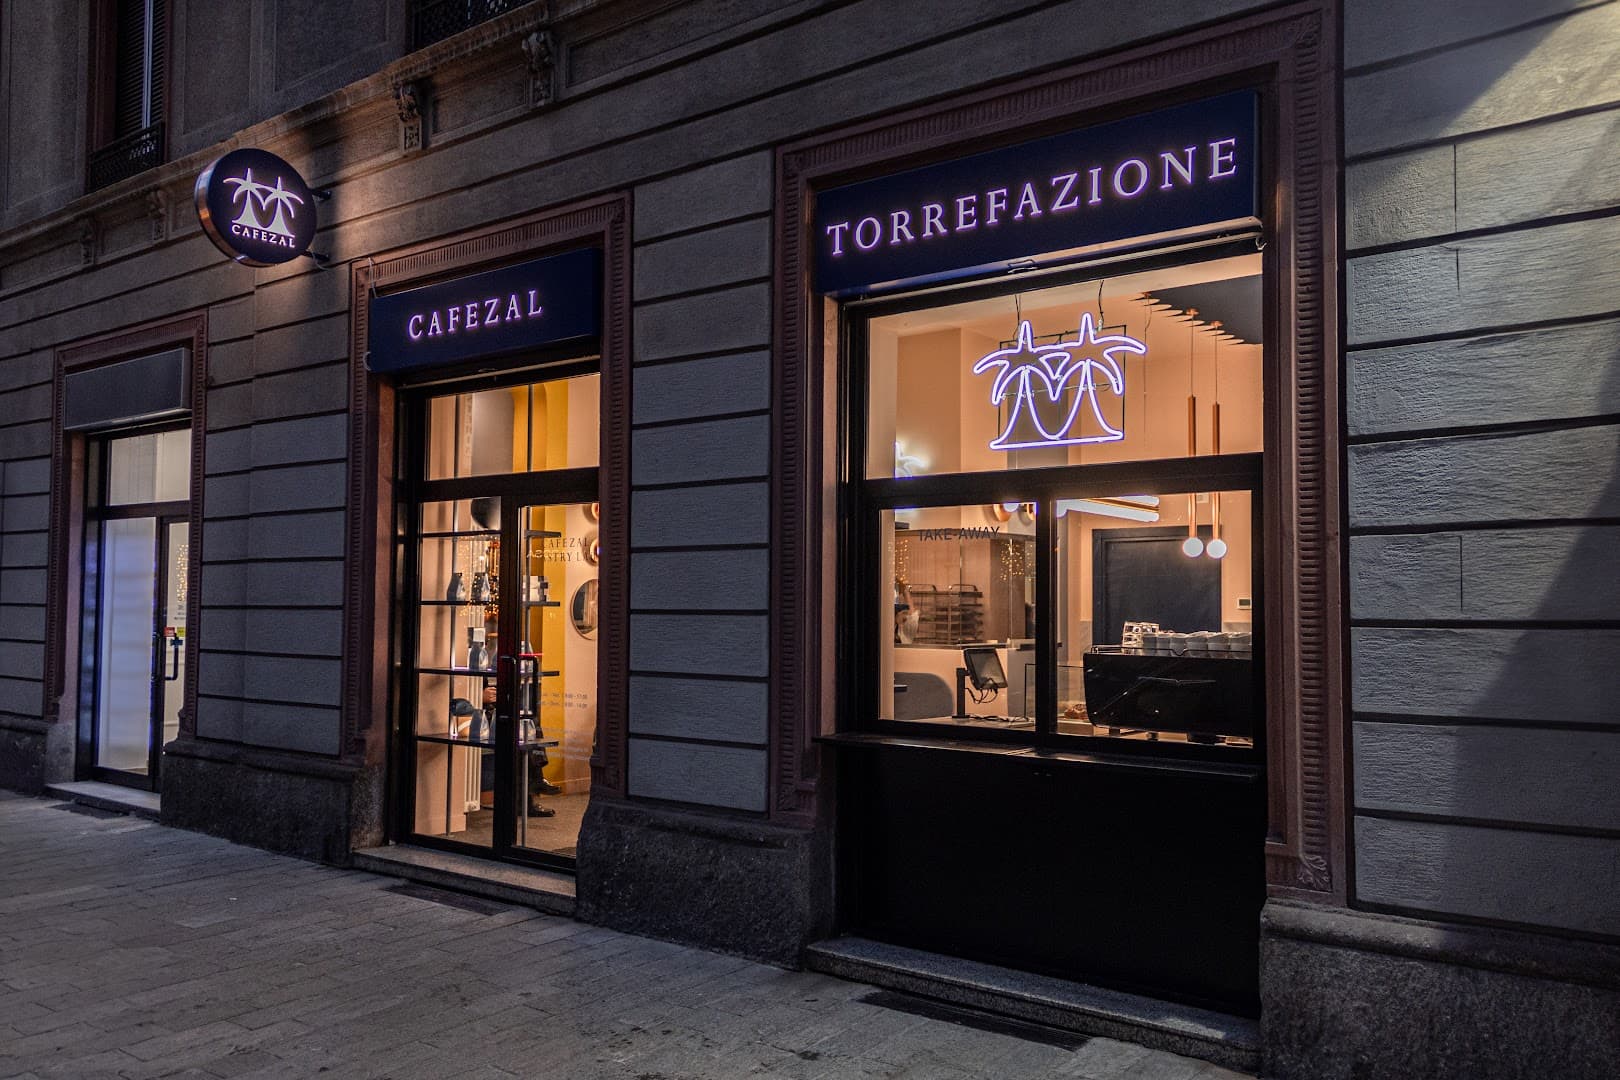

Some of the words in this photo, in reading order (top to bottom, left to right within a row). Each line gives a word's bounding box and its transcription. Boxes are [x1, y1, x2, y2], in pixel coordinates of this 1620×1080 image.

[826, 137, 1238, 256] TORREFAZIONE
[231, 224, 295, 248] CAFEZAL
[408, 290, 542, 340] CAFEZAL
[919, 526, 1000, 541] TAKE-AWAY
